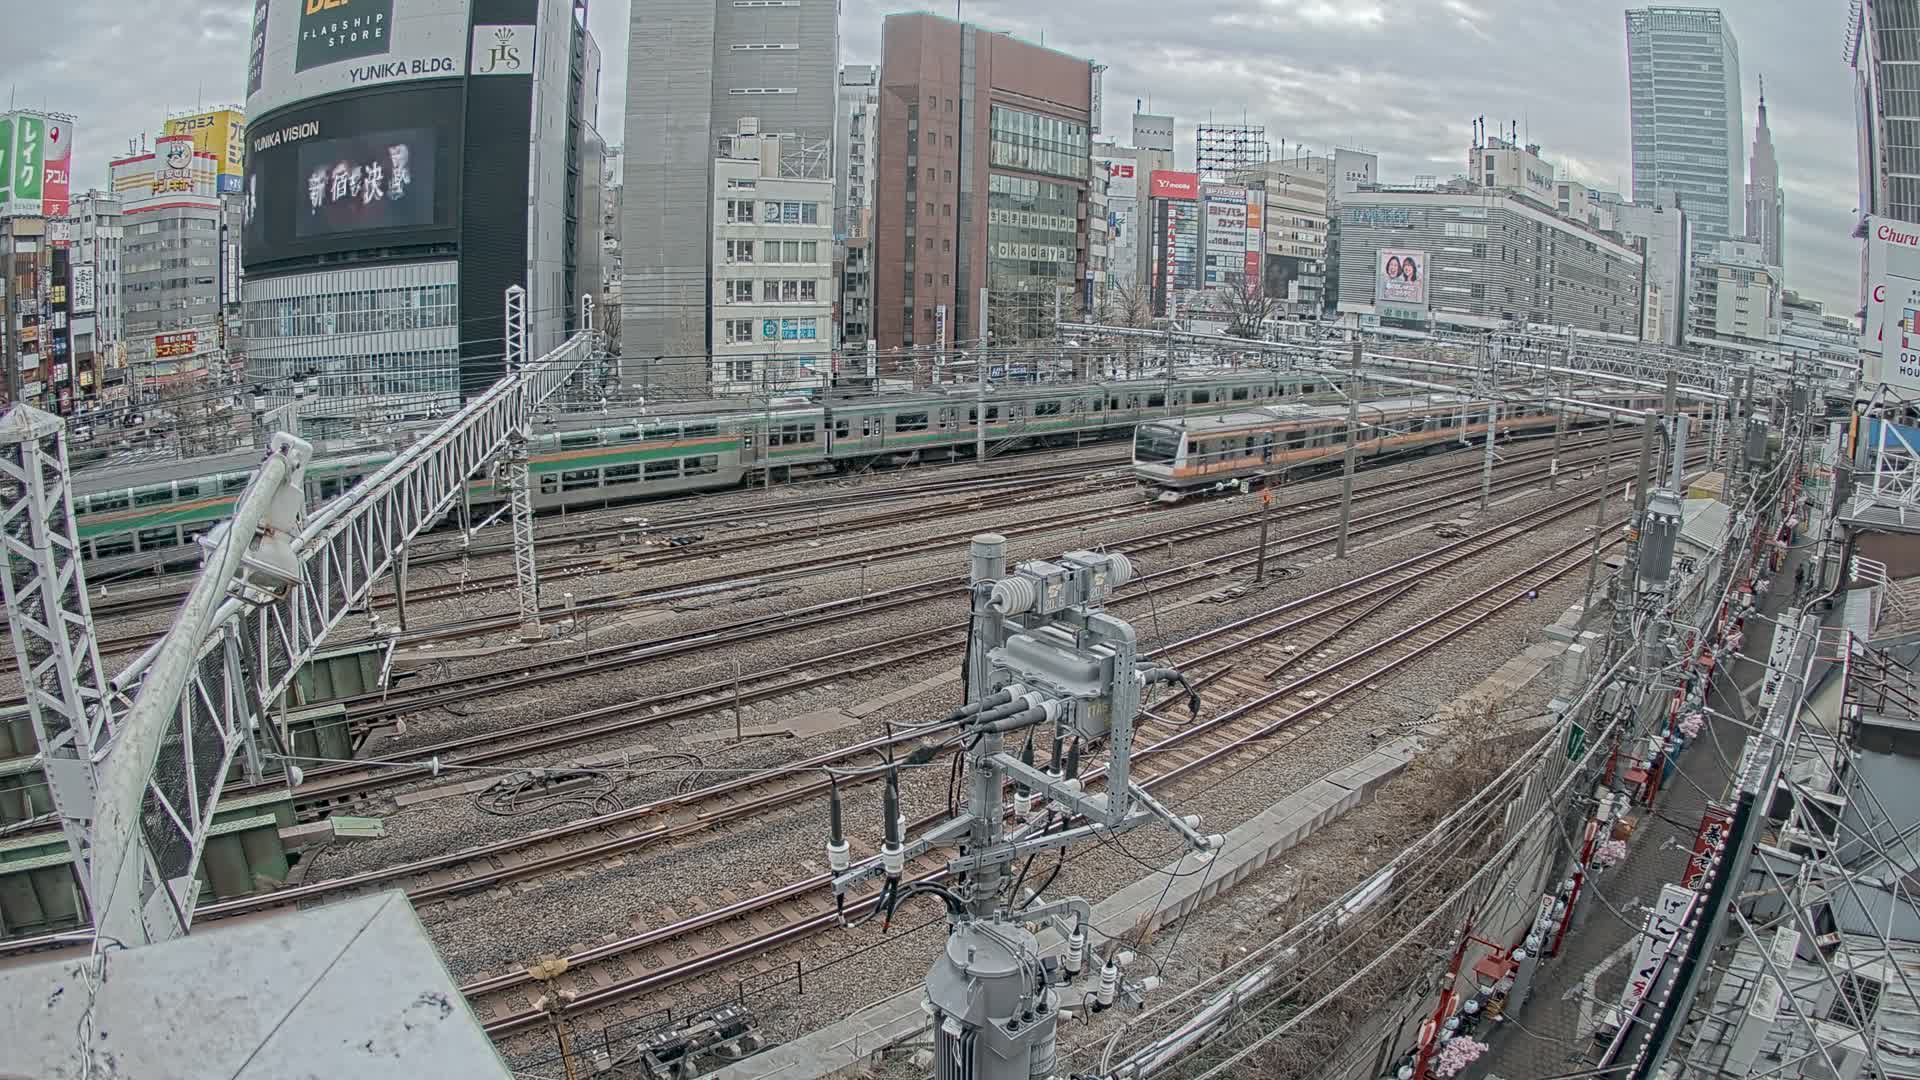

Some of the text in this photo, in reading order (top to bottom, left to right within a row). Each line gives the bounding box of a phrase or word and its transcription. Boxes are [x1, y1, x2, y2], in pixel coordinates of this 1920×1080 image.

[303, 13, 384, 41] FLAGSHIP
[328, 28, 382, 47] STORE
[349, 57, 456, 83] YUNIKA BLDG.
[175, 116, 215, 132] プロミス
[1134, 127, 1173, 137] TAKANO
[253, 120, 320, 153] YUNIKA VISION
[21, 120, 38, 188] レイク
[45, 168, 68, 185] アコム
[1877, 224, 1919, 247] Churu
[1000, 245, 1065, 261] okadaya
[1900, 352, 1920, 366] OP
